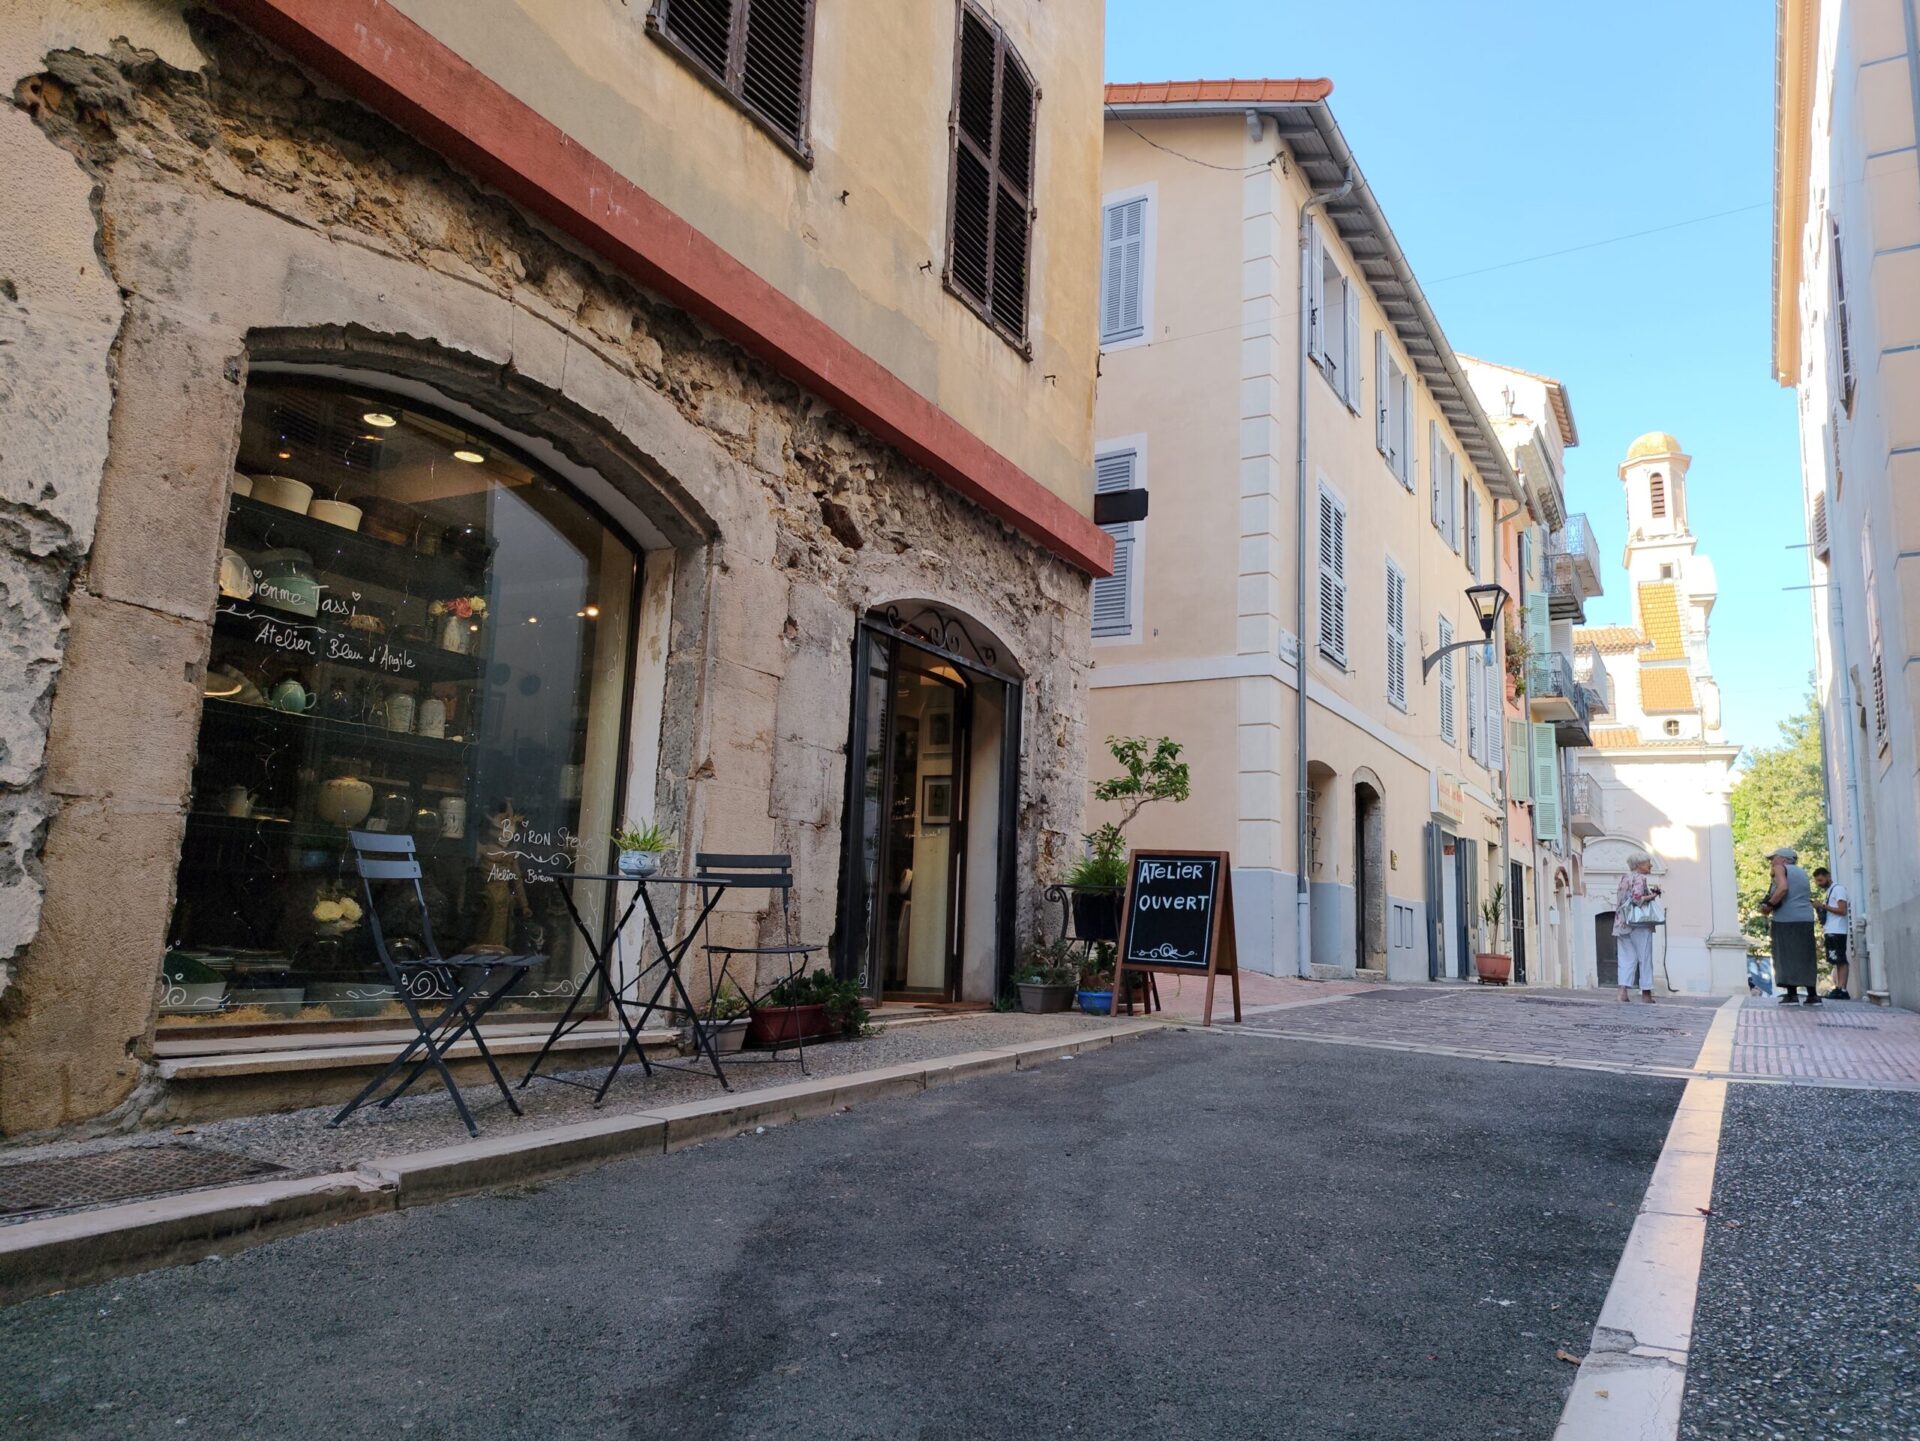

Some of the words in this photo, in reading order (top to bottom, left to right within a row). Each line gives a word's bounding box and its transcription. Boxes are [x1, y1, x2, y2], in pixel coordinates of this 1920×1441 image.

[311, 585, 361, 617] Tassi
[255, 622, 316, 655] Atelier
[326, 637, 363, 659] Bleu
[487, 863, 519, 882] Atelier
